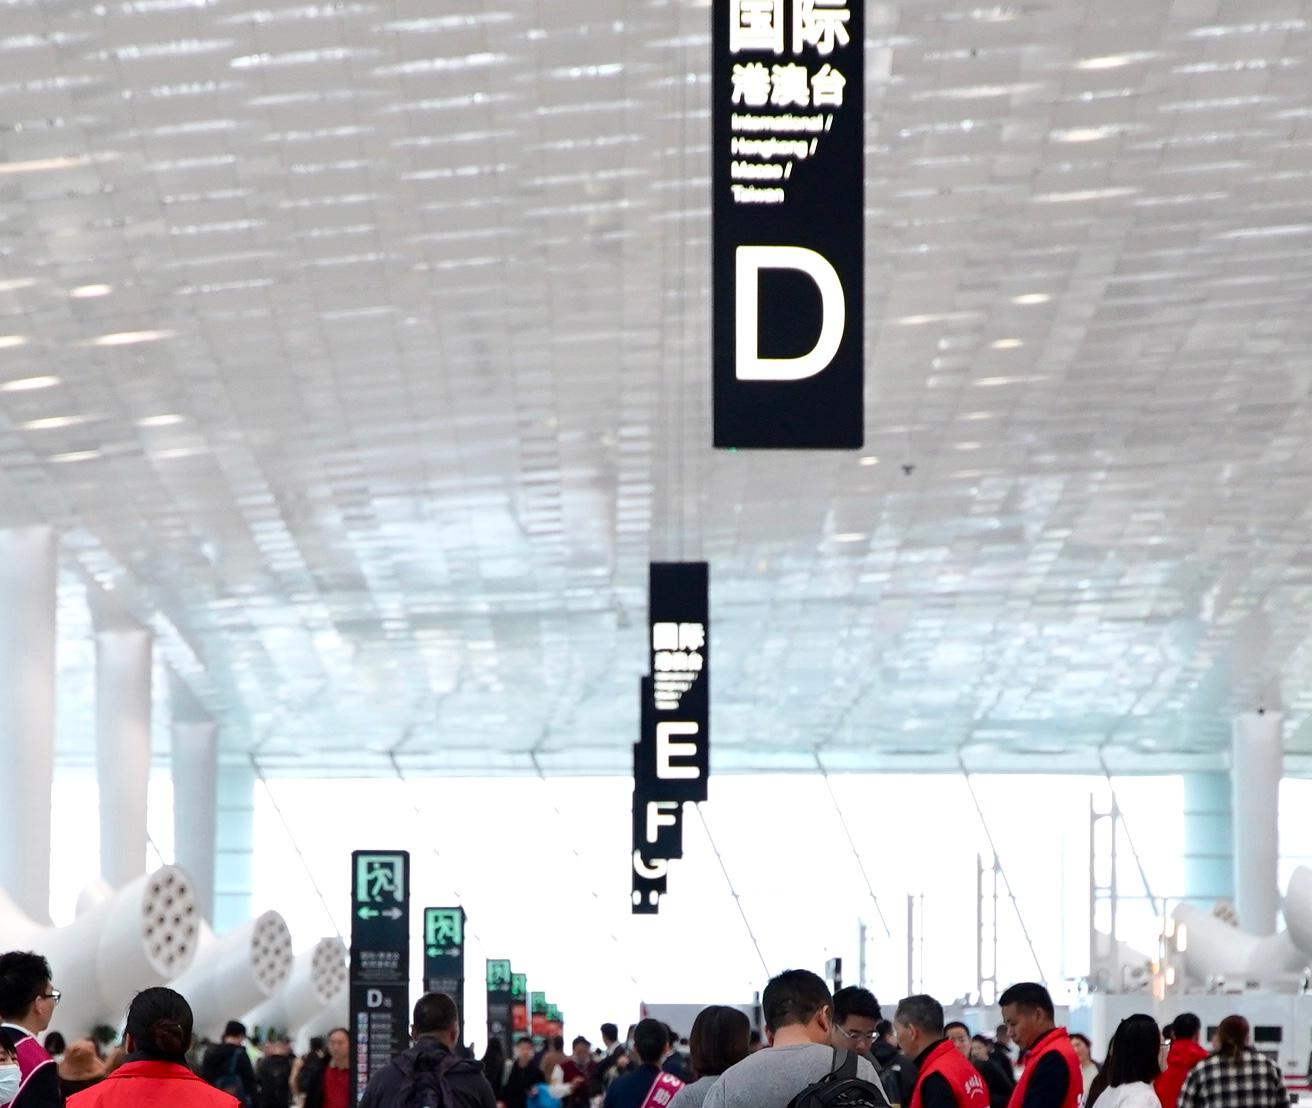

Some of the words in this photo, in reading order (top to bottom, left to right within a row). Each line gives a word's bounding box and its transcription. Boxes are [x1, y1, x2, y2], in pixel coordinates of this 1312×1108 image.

[730, 0, 850, 55] 国际
[731, 62, 846, 106] 港澳台
[736, 246, 845, 380] D
[657, 722, 700, 779] E
[646, 801, 679, 843] F
